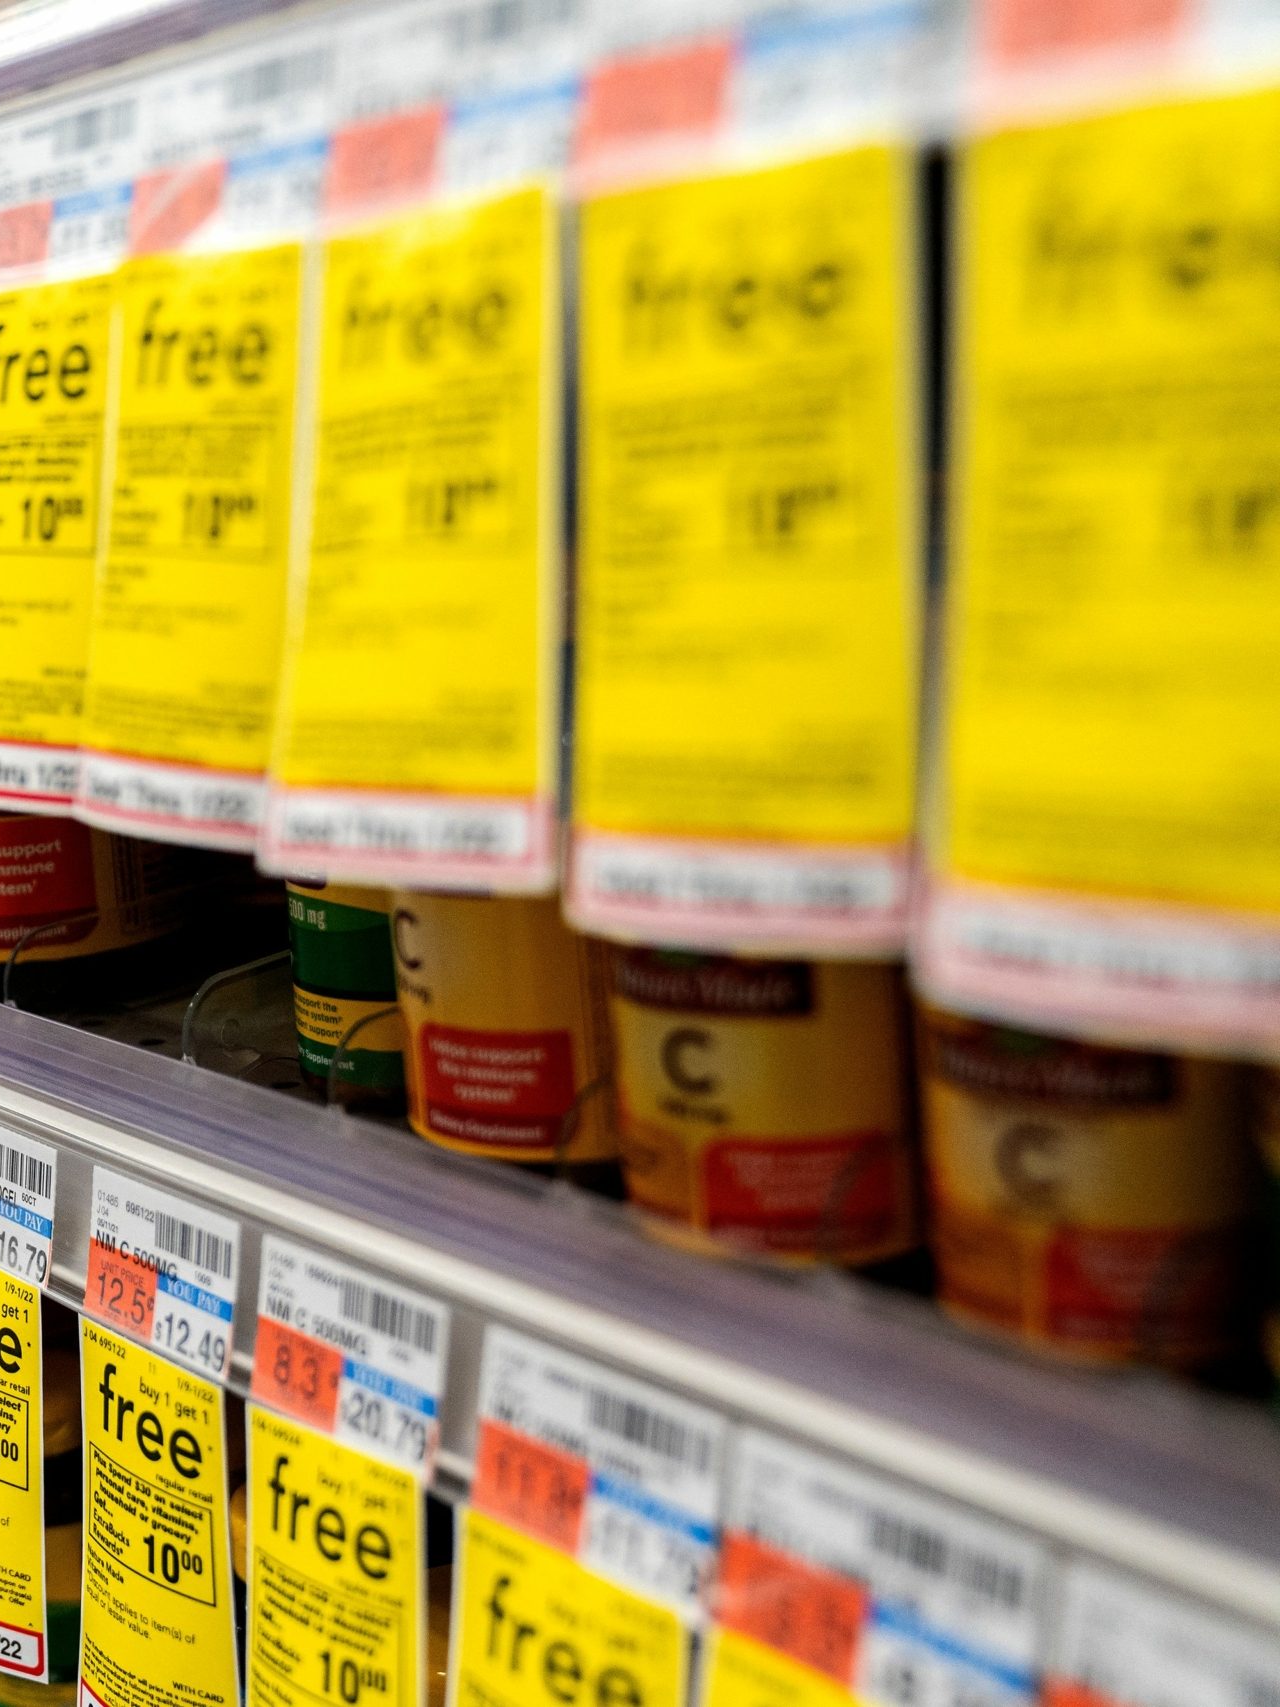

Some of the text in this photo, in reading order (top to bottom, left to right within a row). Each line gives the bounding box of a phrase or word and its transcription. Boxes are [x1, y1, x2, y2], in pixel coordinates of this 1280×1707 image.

[137, 298, 269, 388] free
[306, 908, 326, 931] mg
[323, 1002, 337, 1013] the
[659, 1027, 714, 1096] C
[21, 1192, 37, 1207] 60CT
[125, 1200, 155, 1223] 695122
[0, 1201, 45, 1232] YOU PAY
[95, 1229, 178, 1282] NM C 500MG
[5, 1281, 34, 1304] 1/9-1/22
[121, 1268, 144, 1288] PRICE
[165, 1278, 221, 1313] YOU PAY
[1, 1303, 20, 1320] get
[23, 1309, 28, 1324] 1
[266, 1297, 307, 1329] NM C
[89, 1330, 97, 1343] 04
[99, 1337, 127, 1360] 695122
[155, 1311, 226, 1372] $12.49
[9, 1382, 30, 1396] retail
[139, 1376, 208, 1425] buy 1 get 1
[99, 1362, 203, 1480] free
[93, 1450, 203, 1520] Plus Spend $30 on select
[155, 1473, 185, 1493] regular
[96, 1467, 199, 1535] personal care, vitamins,
[99, 1481, 191, 1545] household or grocery
[0, 1516, 10, 1527] of
[268, 1455, 392, 1580] free
[9, 1569, 31, 1582] CARD
[106, 1561, 124, 1584] Made
[113, 1597, 196, 1644] applies to item(s) of
[172, 1680, 224, 1704] WITH CARD
